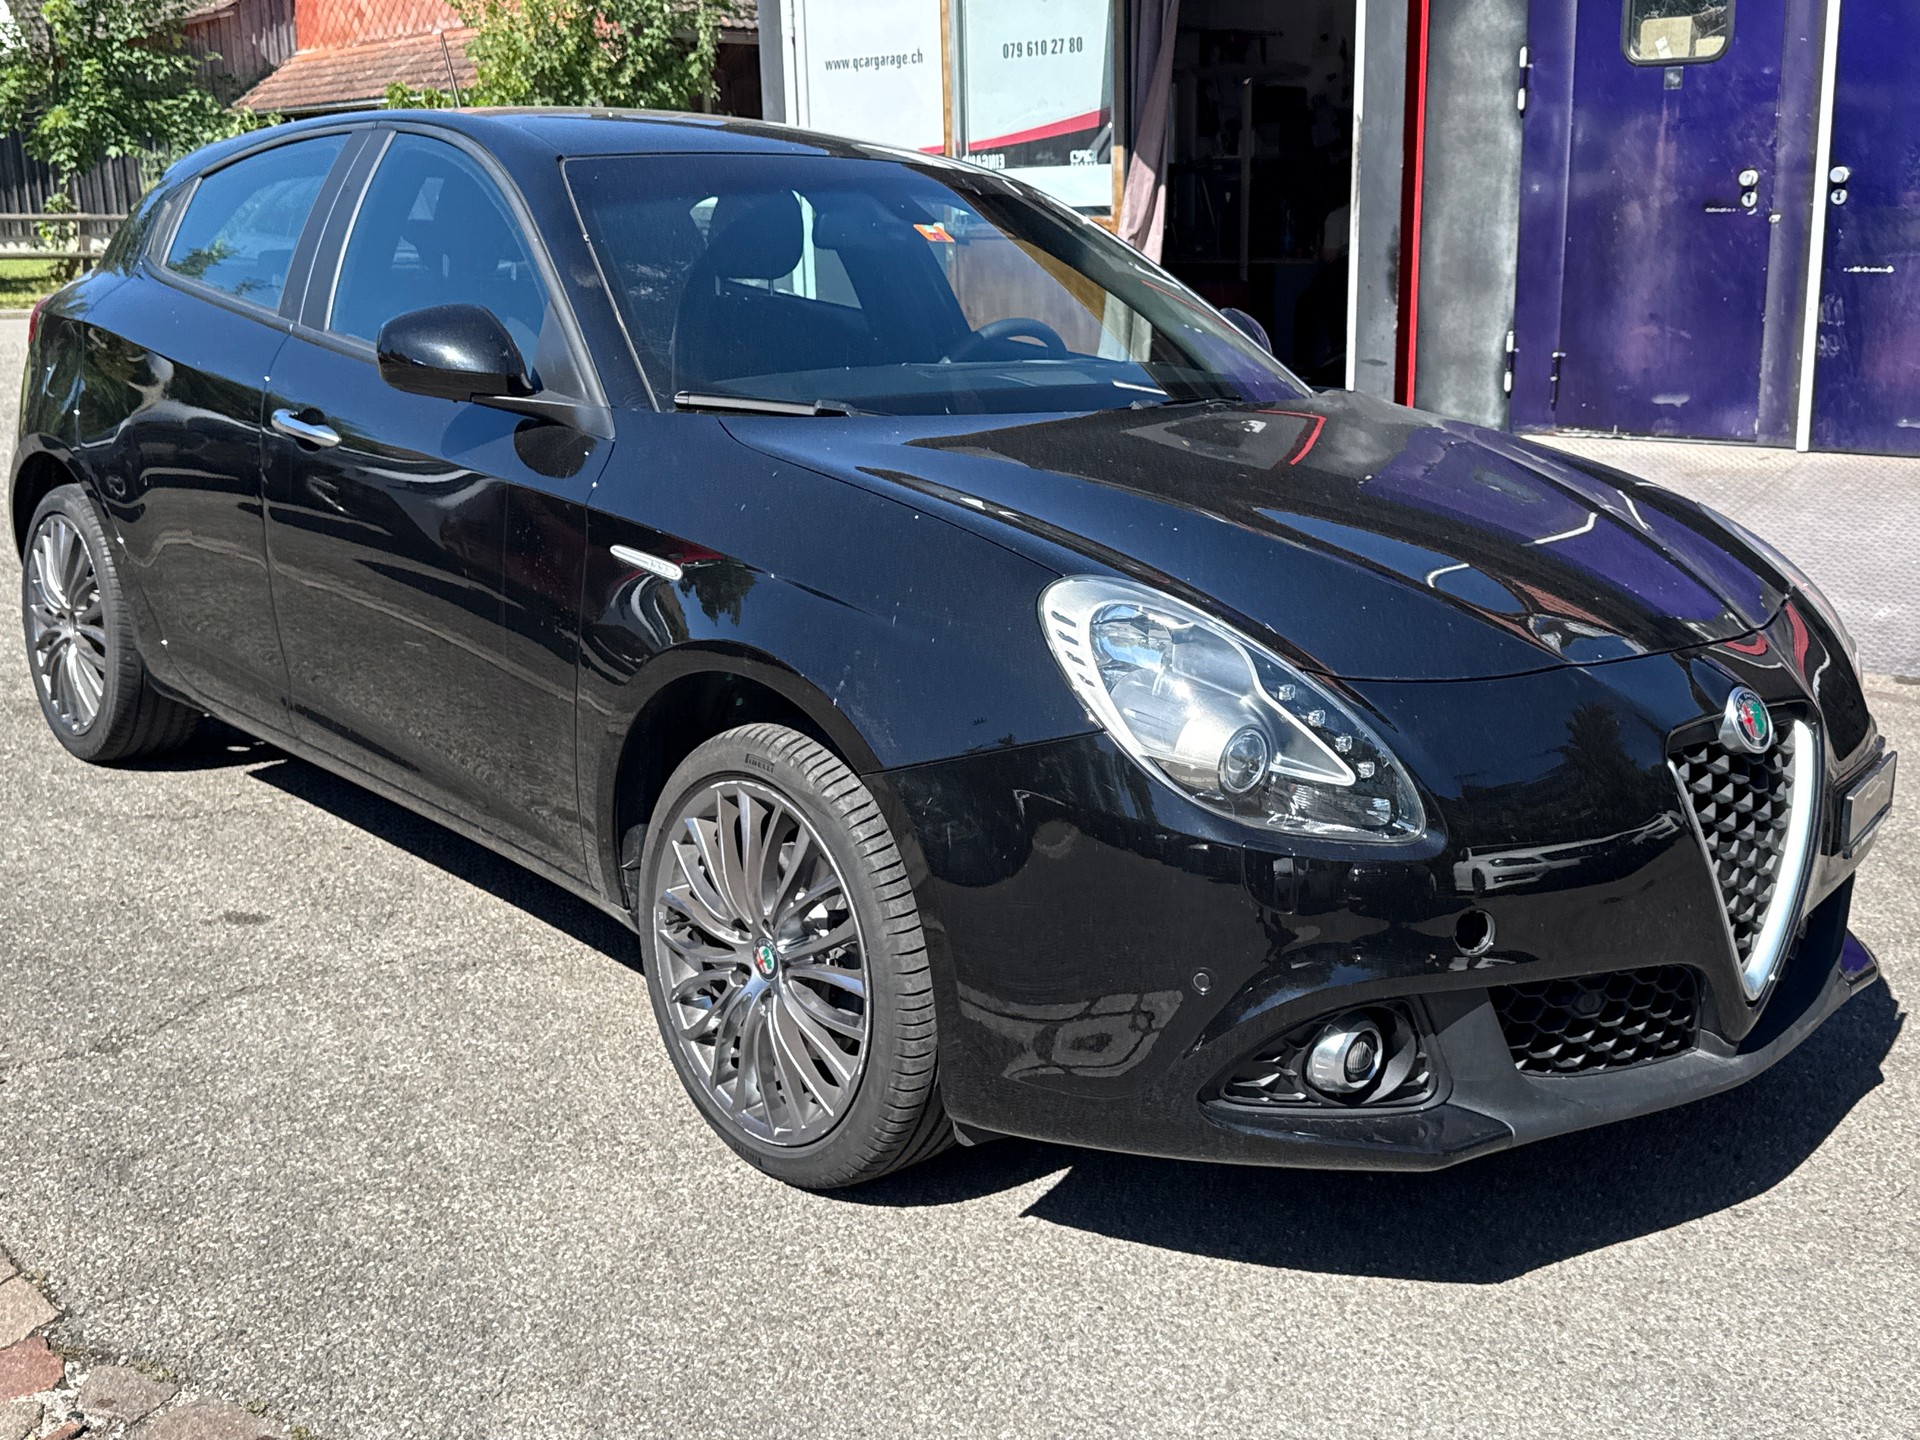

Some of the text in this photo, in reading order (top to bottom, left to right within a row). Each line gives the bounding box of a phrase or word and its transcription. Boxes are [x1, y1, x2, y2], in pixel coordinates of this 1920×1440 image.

[824, 47, 924, 72] www.qcargarage.ch
[1003, 36, 1083, 59] 079 610 27 80
